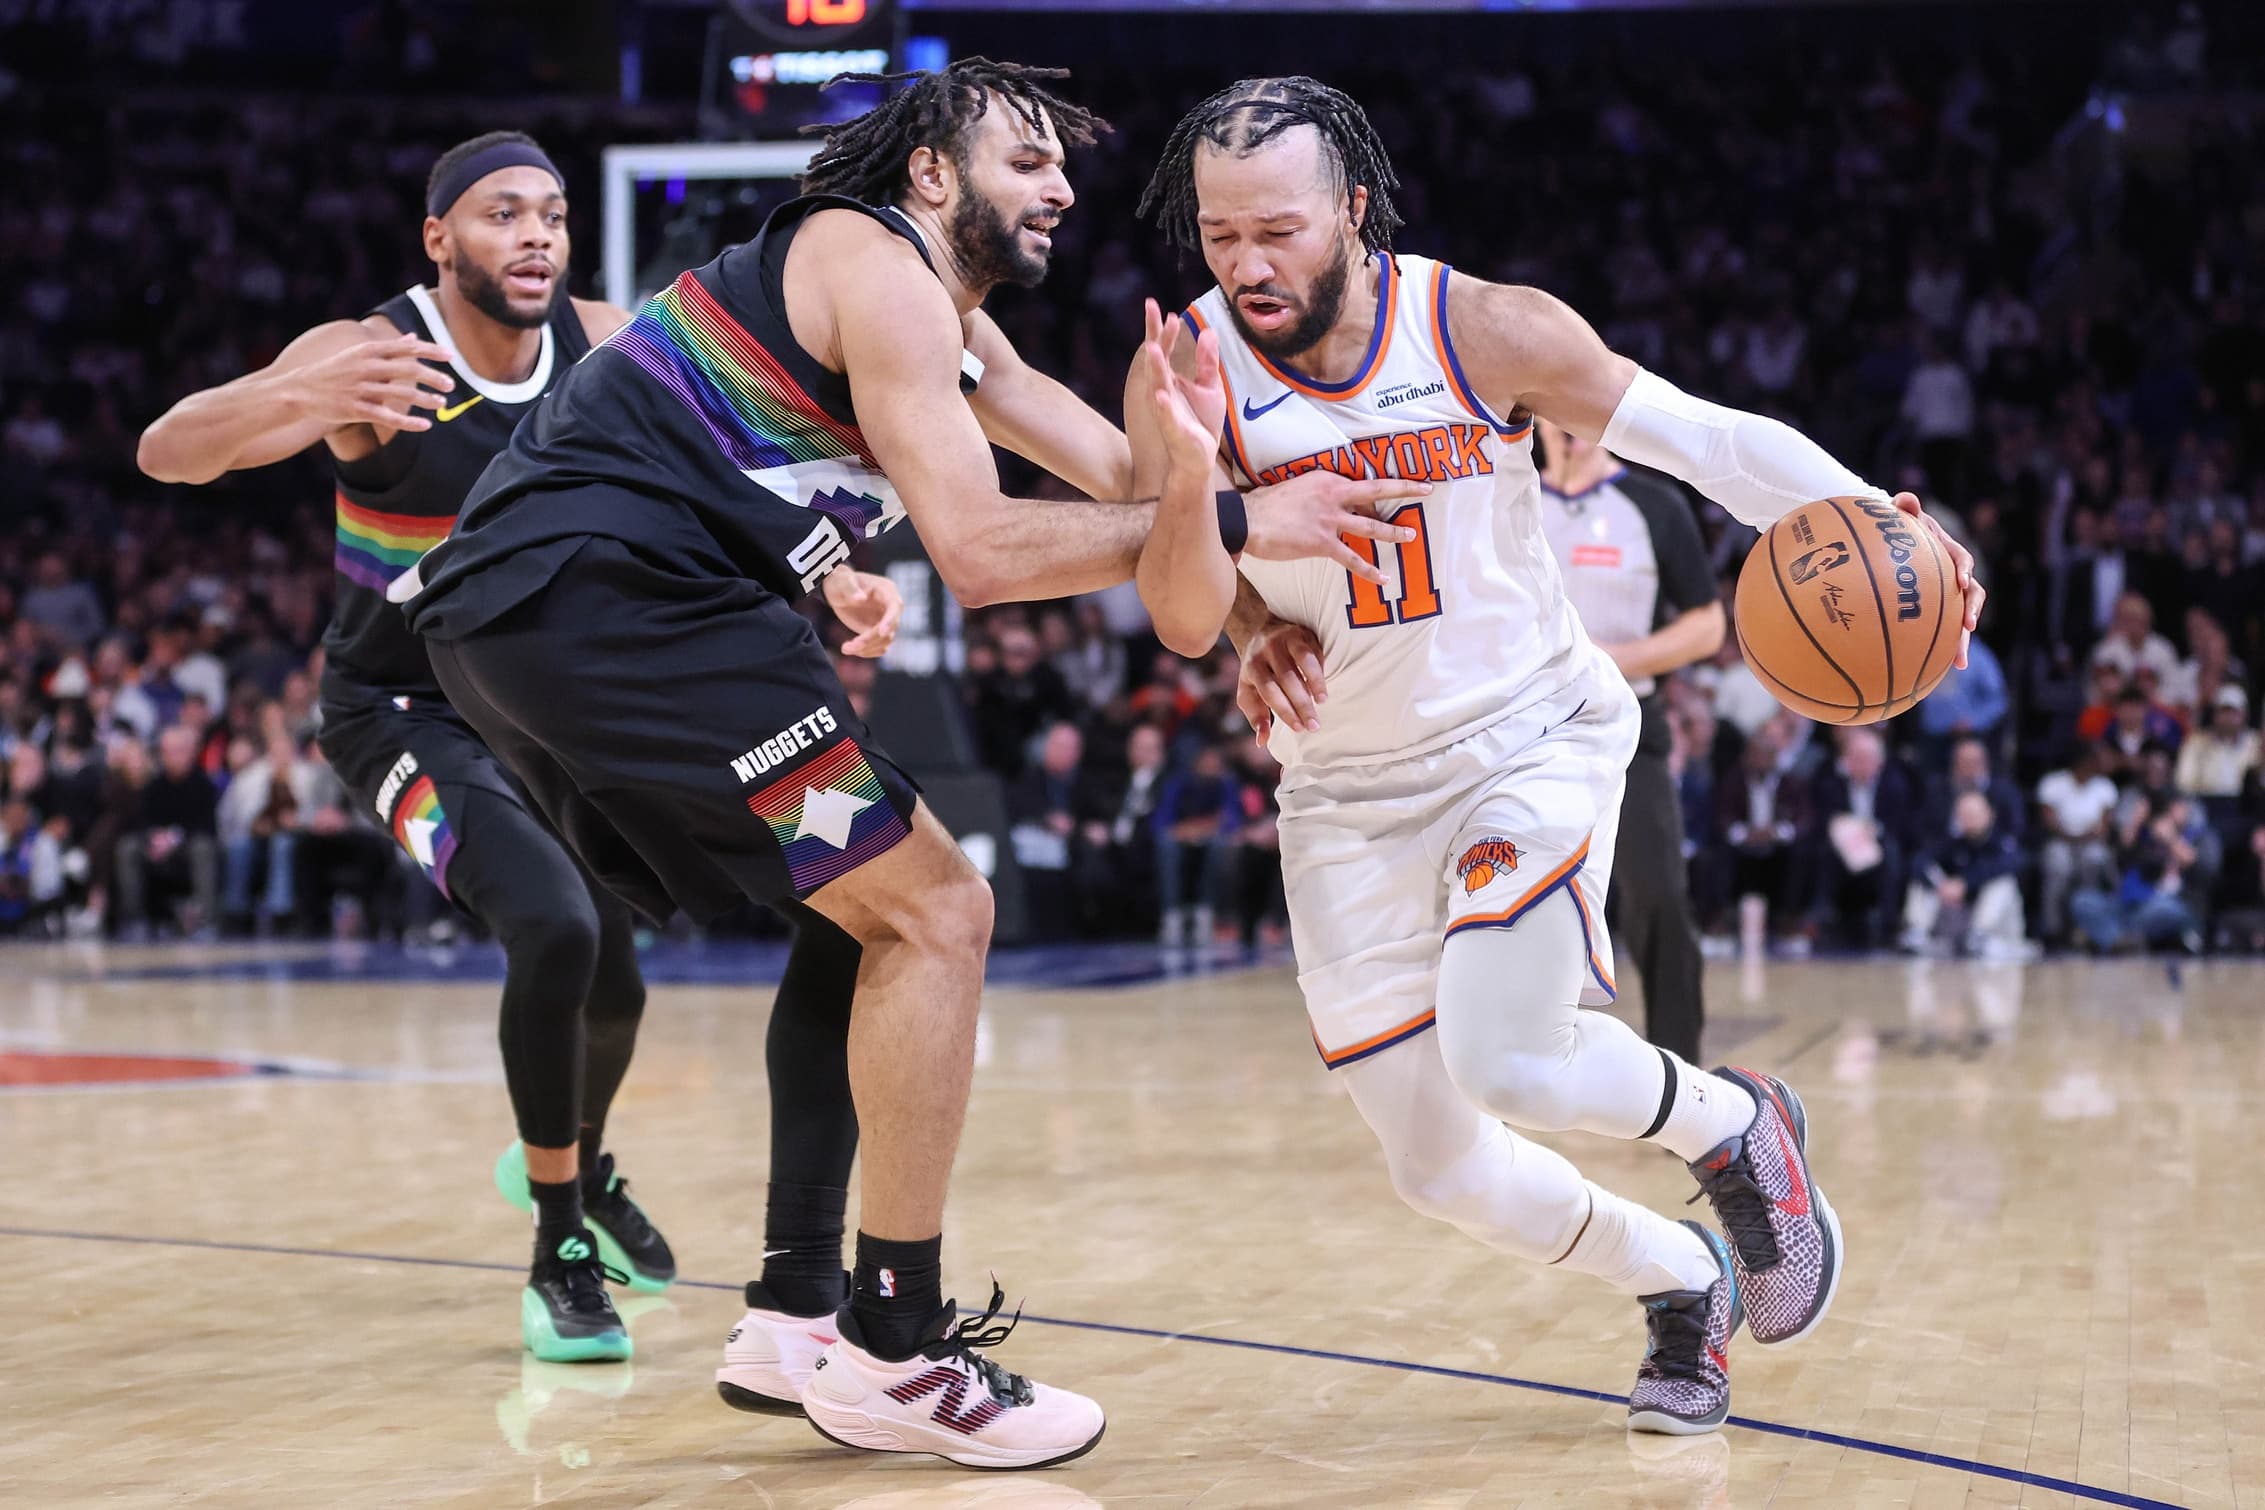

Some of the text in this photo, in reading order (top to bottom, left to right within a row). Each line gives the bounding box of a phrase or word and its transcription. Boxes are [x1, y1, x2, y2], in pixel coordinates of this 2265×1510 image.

[1375, 382, 1412, 396] experience
[1377, 379, 1445, 409] abu dhabi
[1352, 424, 1494, 482] YORK
[1342, 502, 1443, 629] 11
[1854, 498, 1922, 622] Wilson
[729, 705, 838, 784] NUGGETS
[1457, 840, 1518, 878] KNICKS
